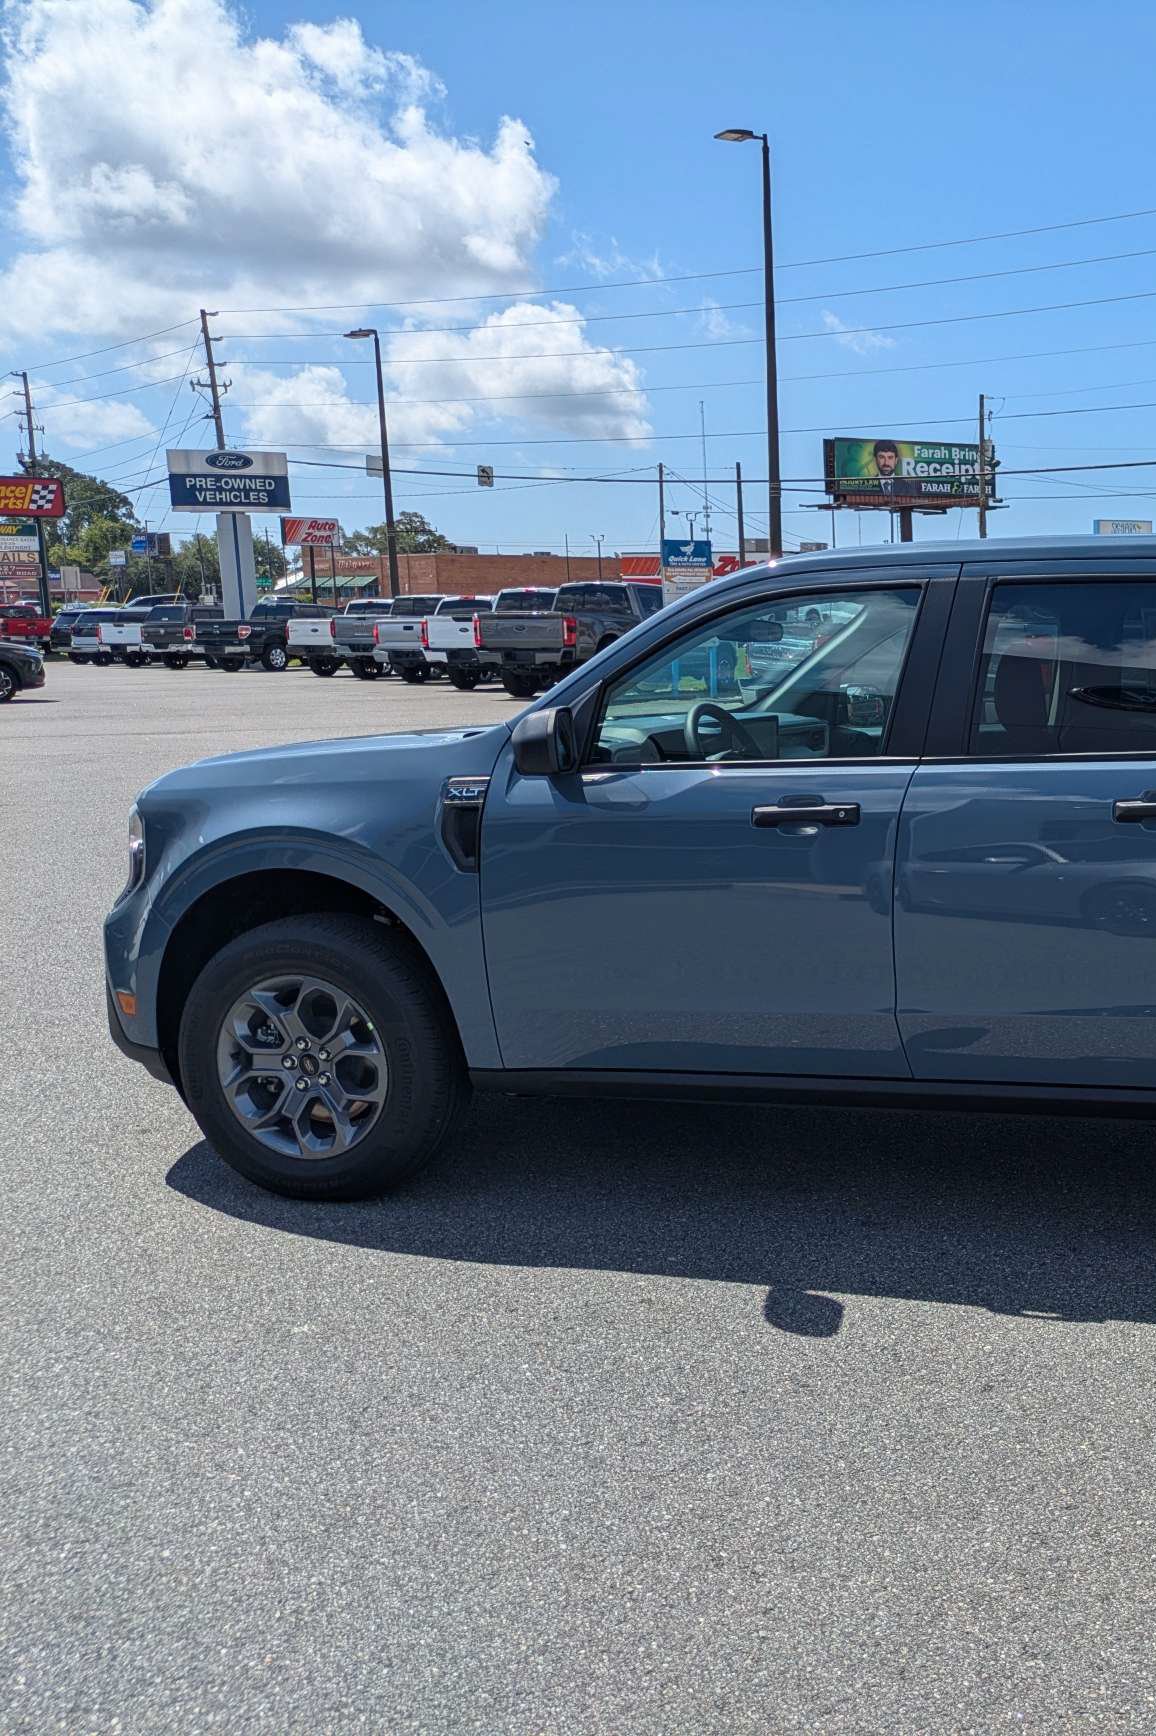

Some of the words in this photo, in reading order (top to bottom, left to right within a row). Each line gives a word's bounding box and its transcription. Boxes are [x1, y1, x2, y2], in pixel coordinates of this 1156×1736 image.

[914, 446, 949, 459] Farah
[951, 447, 991, 462] Brin
[216, 456, 244, 467] Ford
[185, 477, 276, 491] PRE-OWNED
[921, 483, 951, 493] FARAH
[963, 485, 992, 494] FARH
[195, 491, 269, 504] VEHICLES
[308, 520, 336, 531] Auto
[302, 532, 334, 544] Zone
[448, 788, 485, 797] XLT
